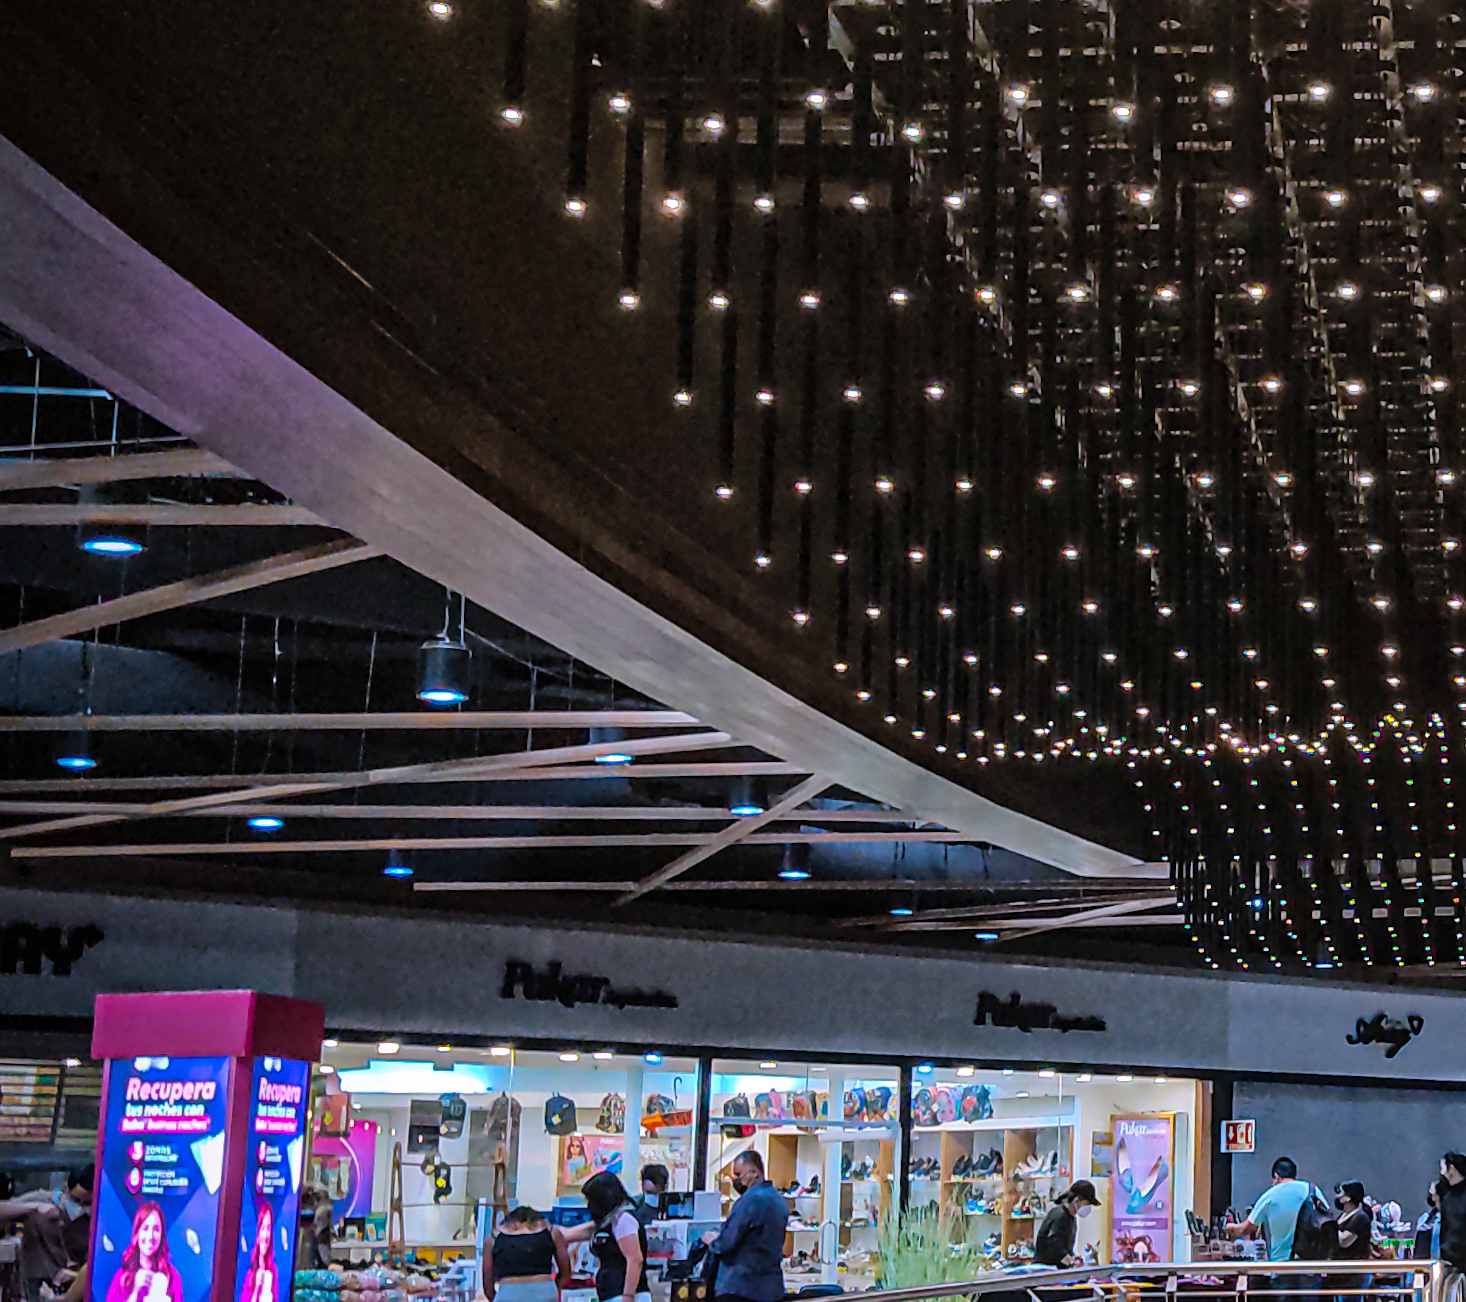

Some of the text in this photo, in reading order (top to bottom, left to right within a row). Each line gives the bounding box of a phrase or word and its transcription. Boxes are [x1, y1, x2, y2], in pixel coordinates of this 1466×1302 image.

[126, 1077, 216, 1105] Recupera
[258, 1077, 301, 1105] Recupera
[125, 1102, 205, 1117] tus noches con
